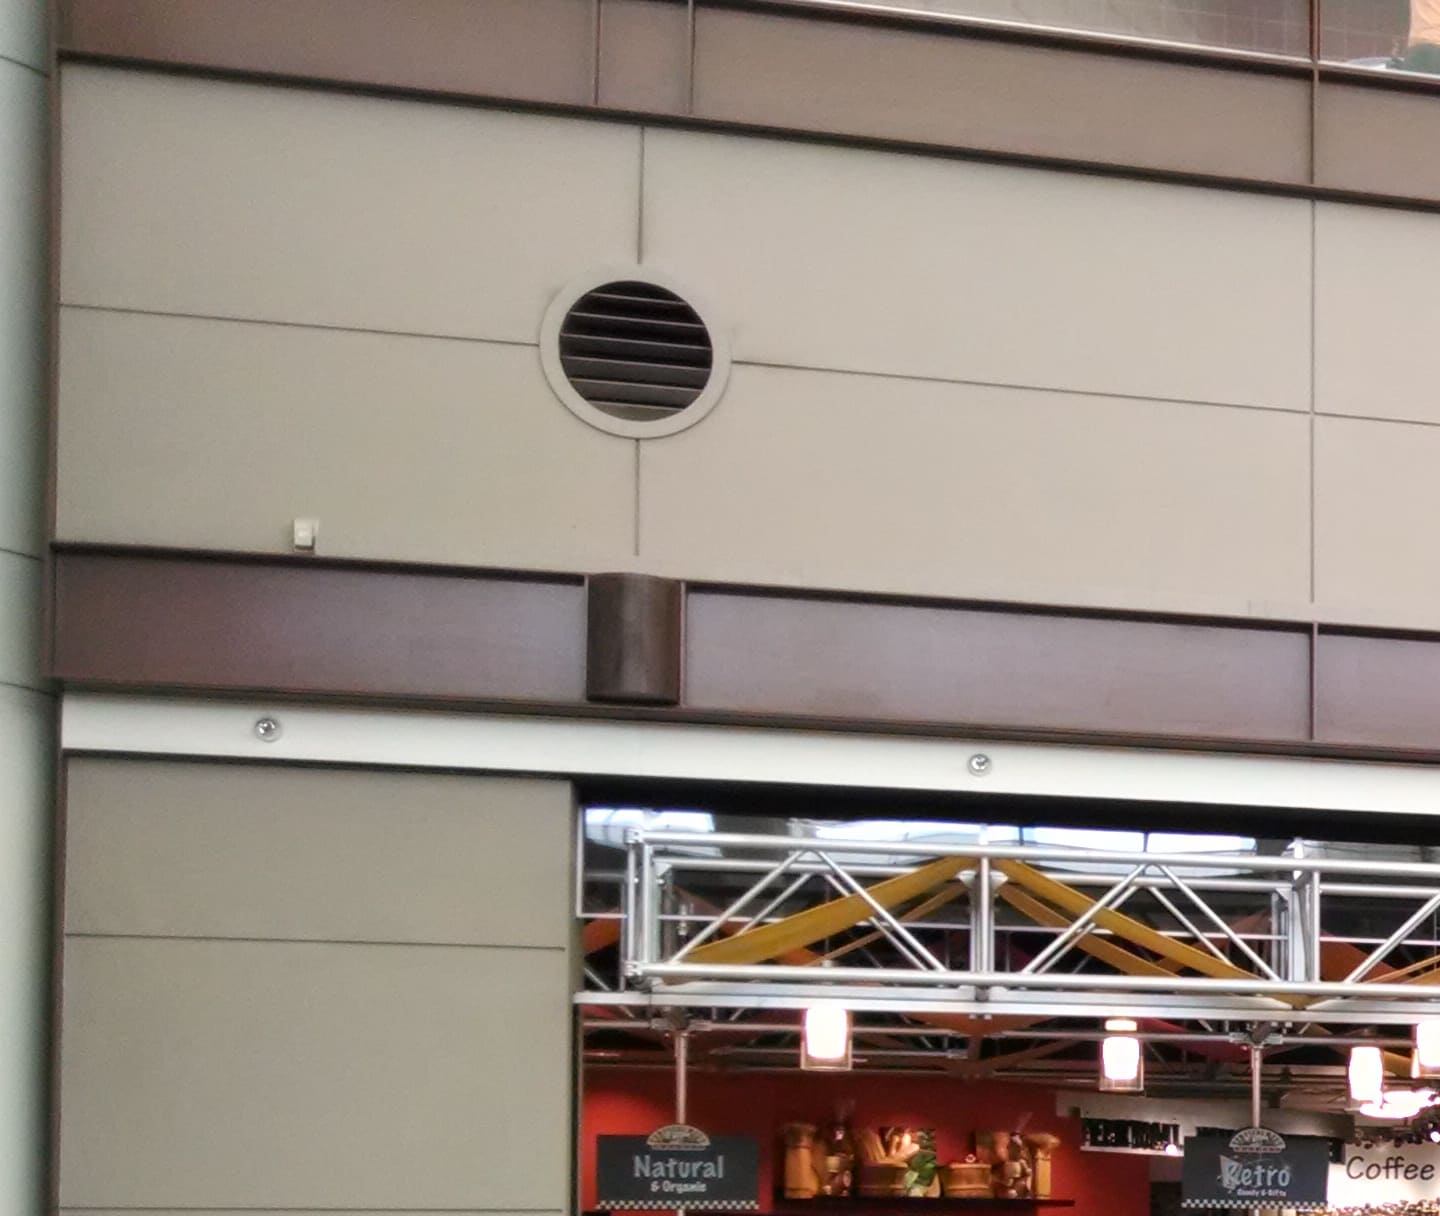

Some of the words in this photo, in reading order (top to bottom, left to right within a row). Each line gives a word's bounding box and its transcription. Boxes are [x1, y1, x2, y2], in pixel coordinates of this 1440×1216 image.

[633, 1154, 724, 1179] Natural
[1221, 1158, 1291, 1188] Retro
[1346, 1155, 1435, 1181] Coffee
[662, 1180, 708, 1194] Organic
